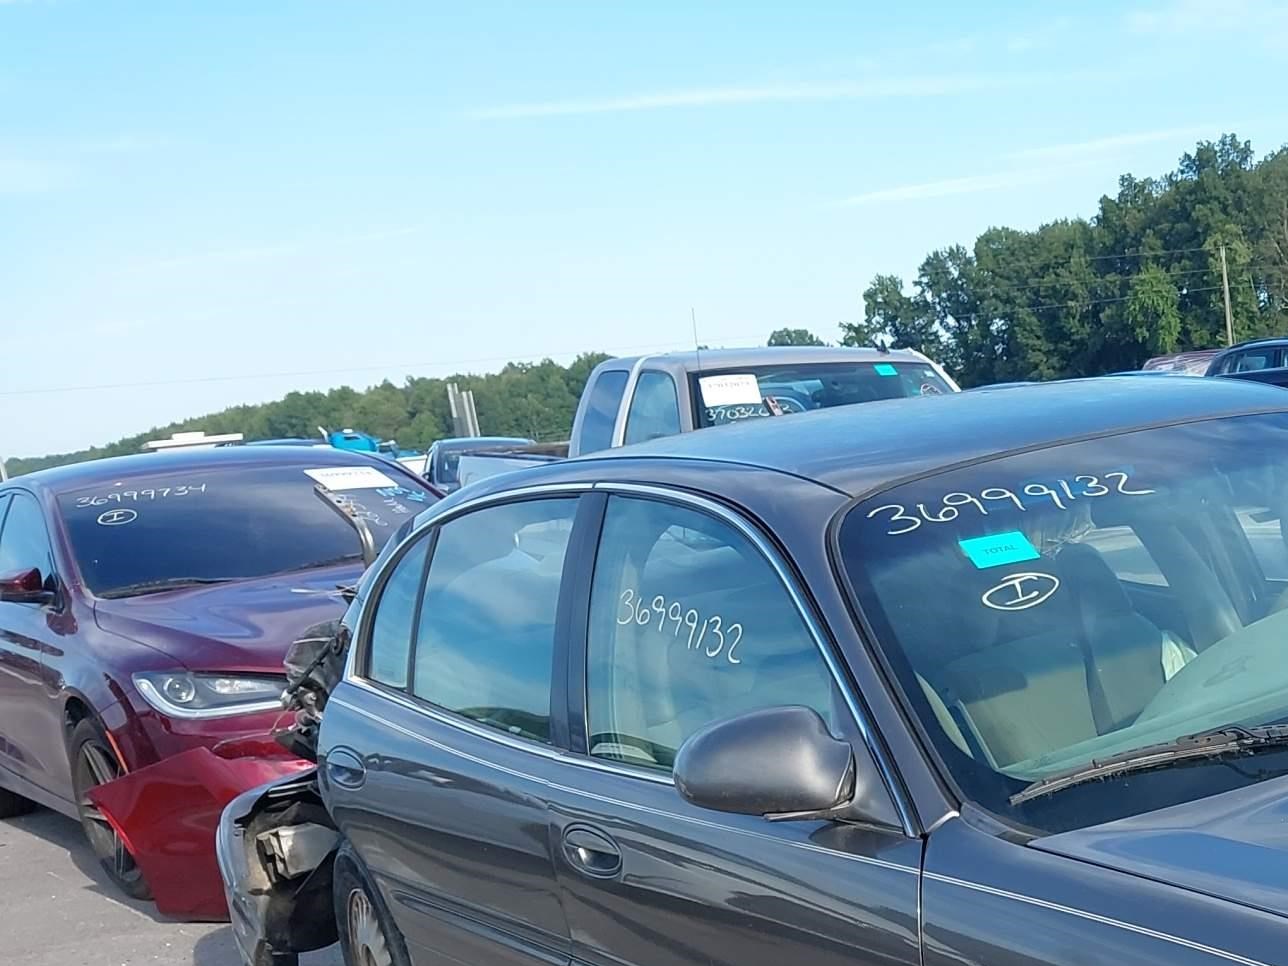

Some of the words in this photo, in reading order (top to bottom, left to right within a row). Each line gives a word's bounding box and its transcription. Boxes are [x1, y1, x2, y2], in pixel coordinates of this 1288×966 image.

[76, 483, 207, 508] 36999734
[866, 472, 1156, 535] 36999132
[616, 588, 743, 664] 36999132
